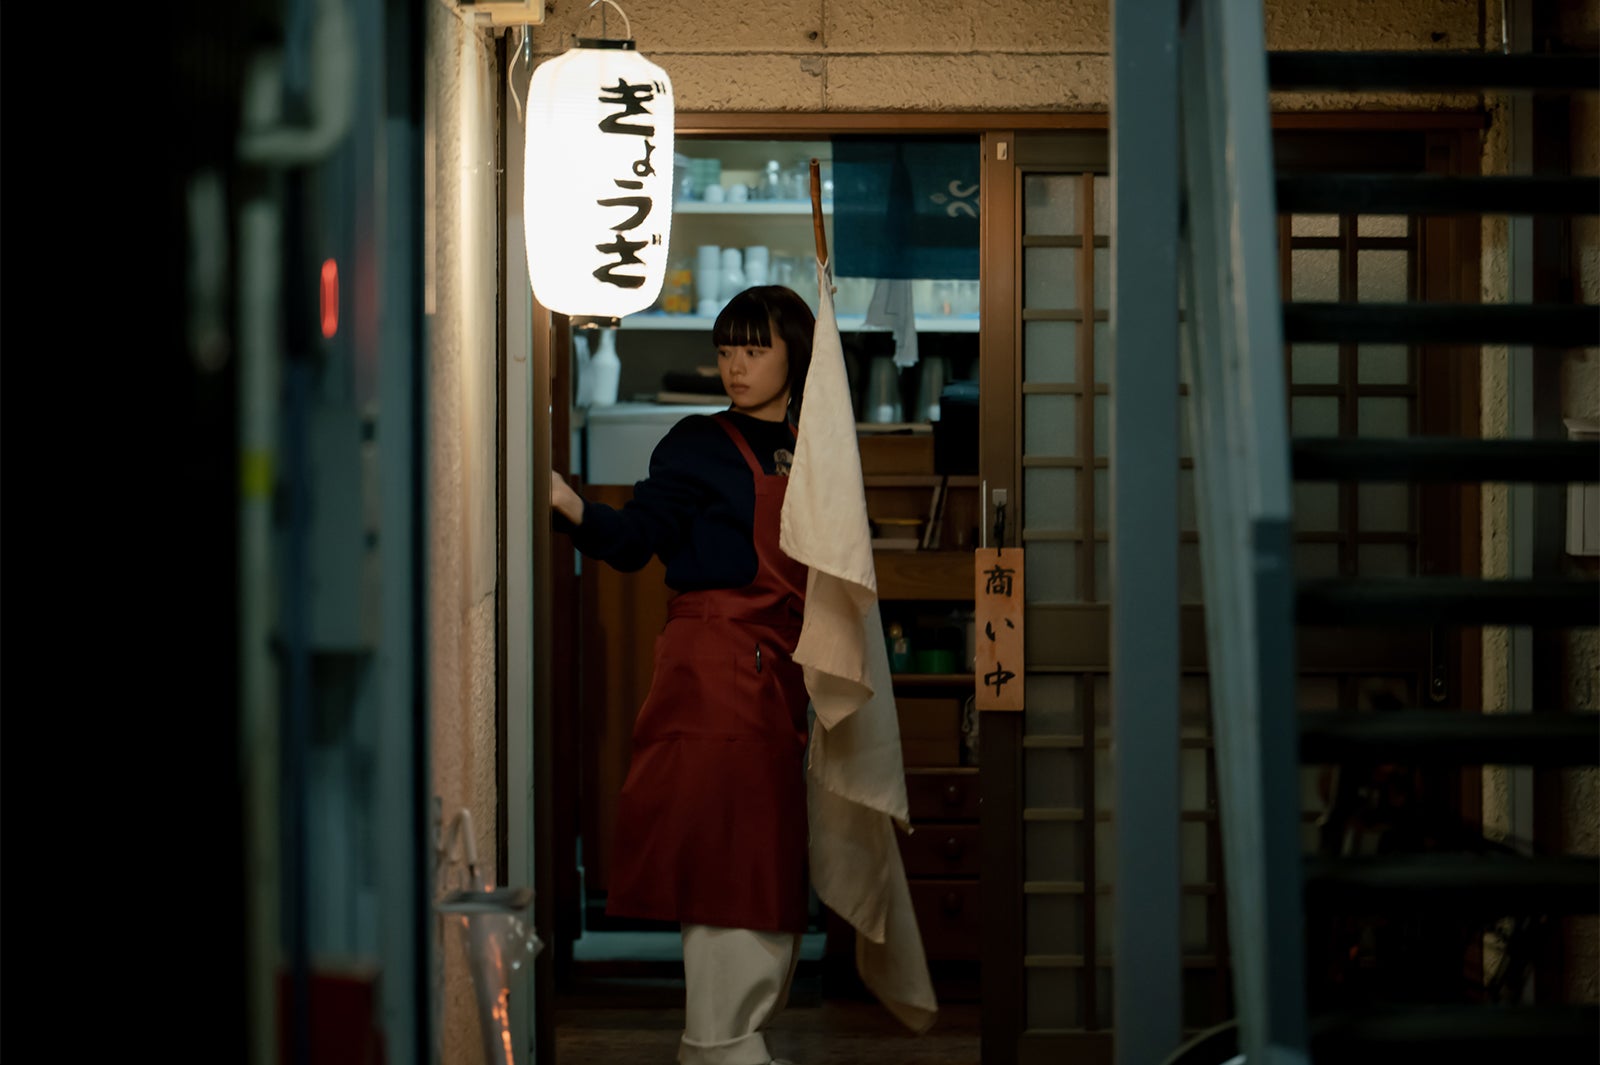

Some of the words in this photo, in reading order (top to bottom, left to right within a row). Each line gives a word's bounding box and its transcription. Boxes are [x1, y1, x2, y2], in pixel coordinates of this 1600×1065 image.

[592, 77, 666, 290] ぎょうざ
[983, 564, 1017, 698] 商い中
